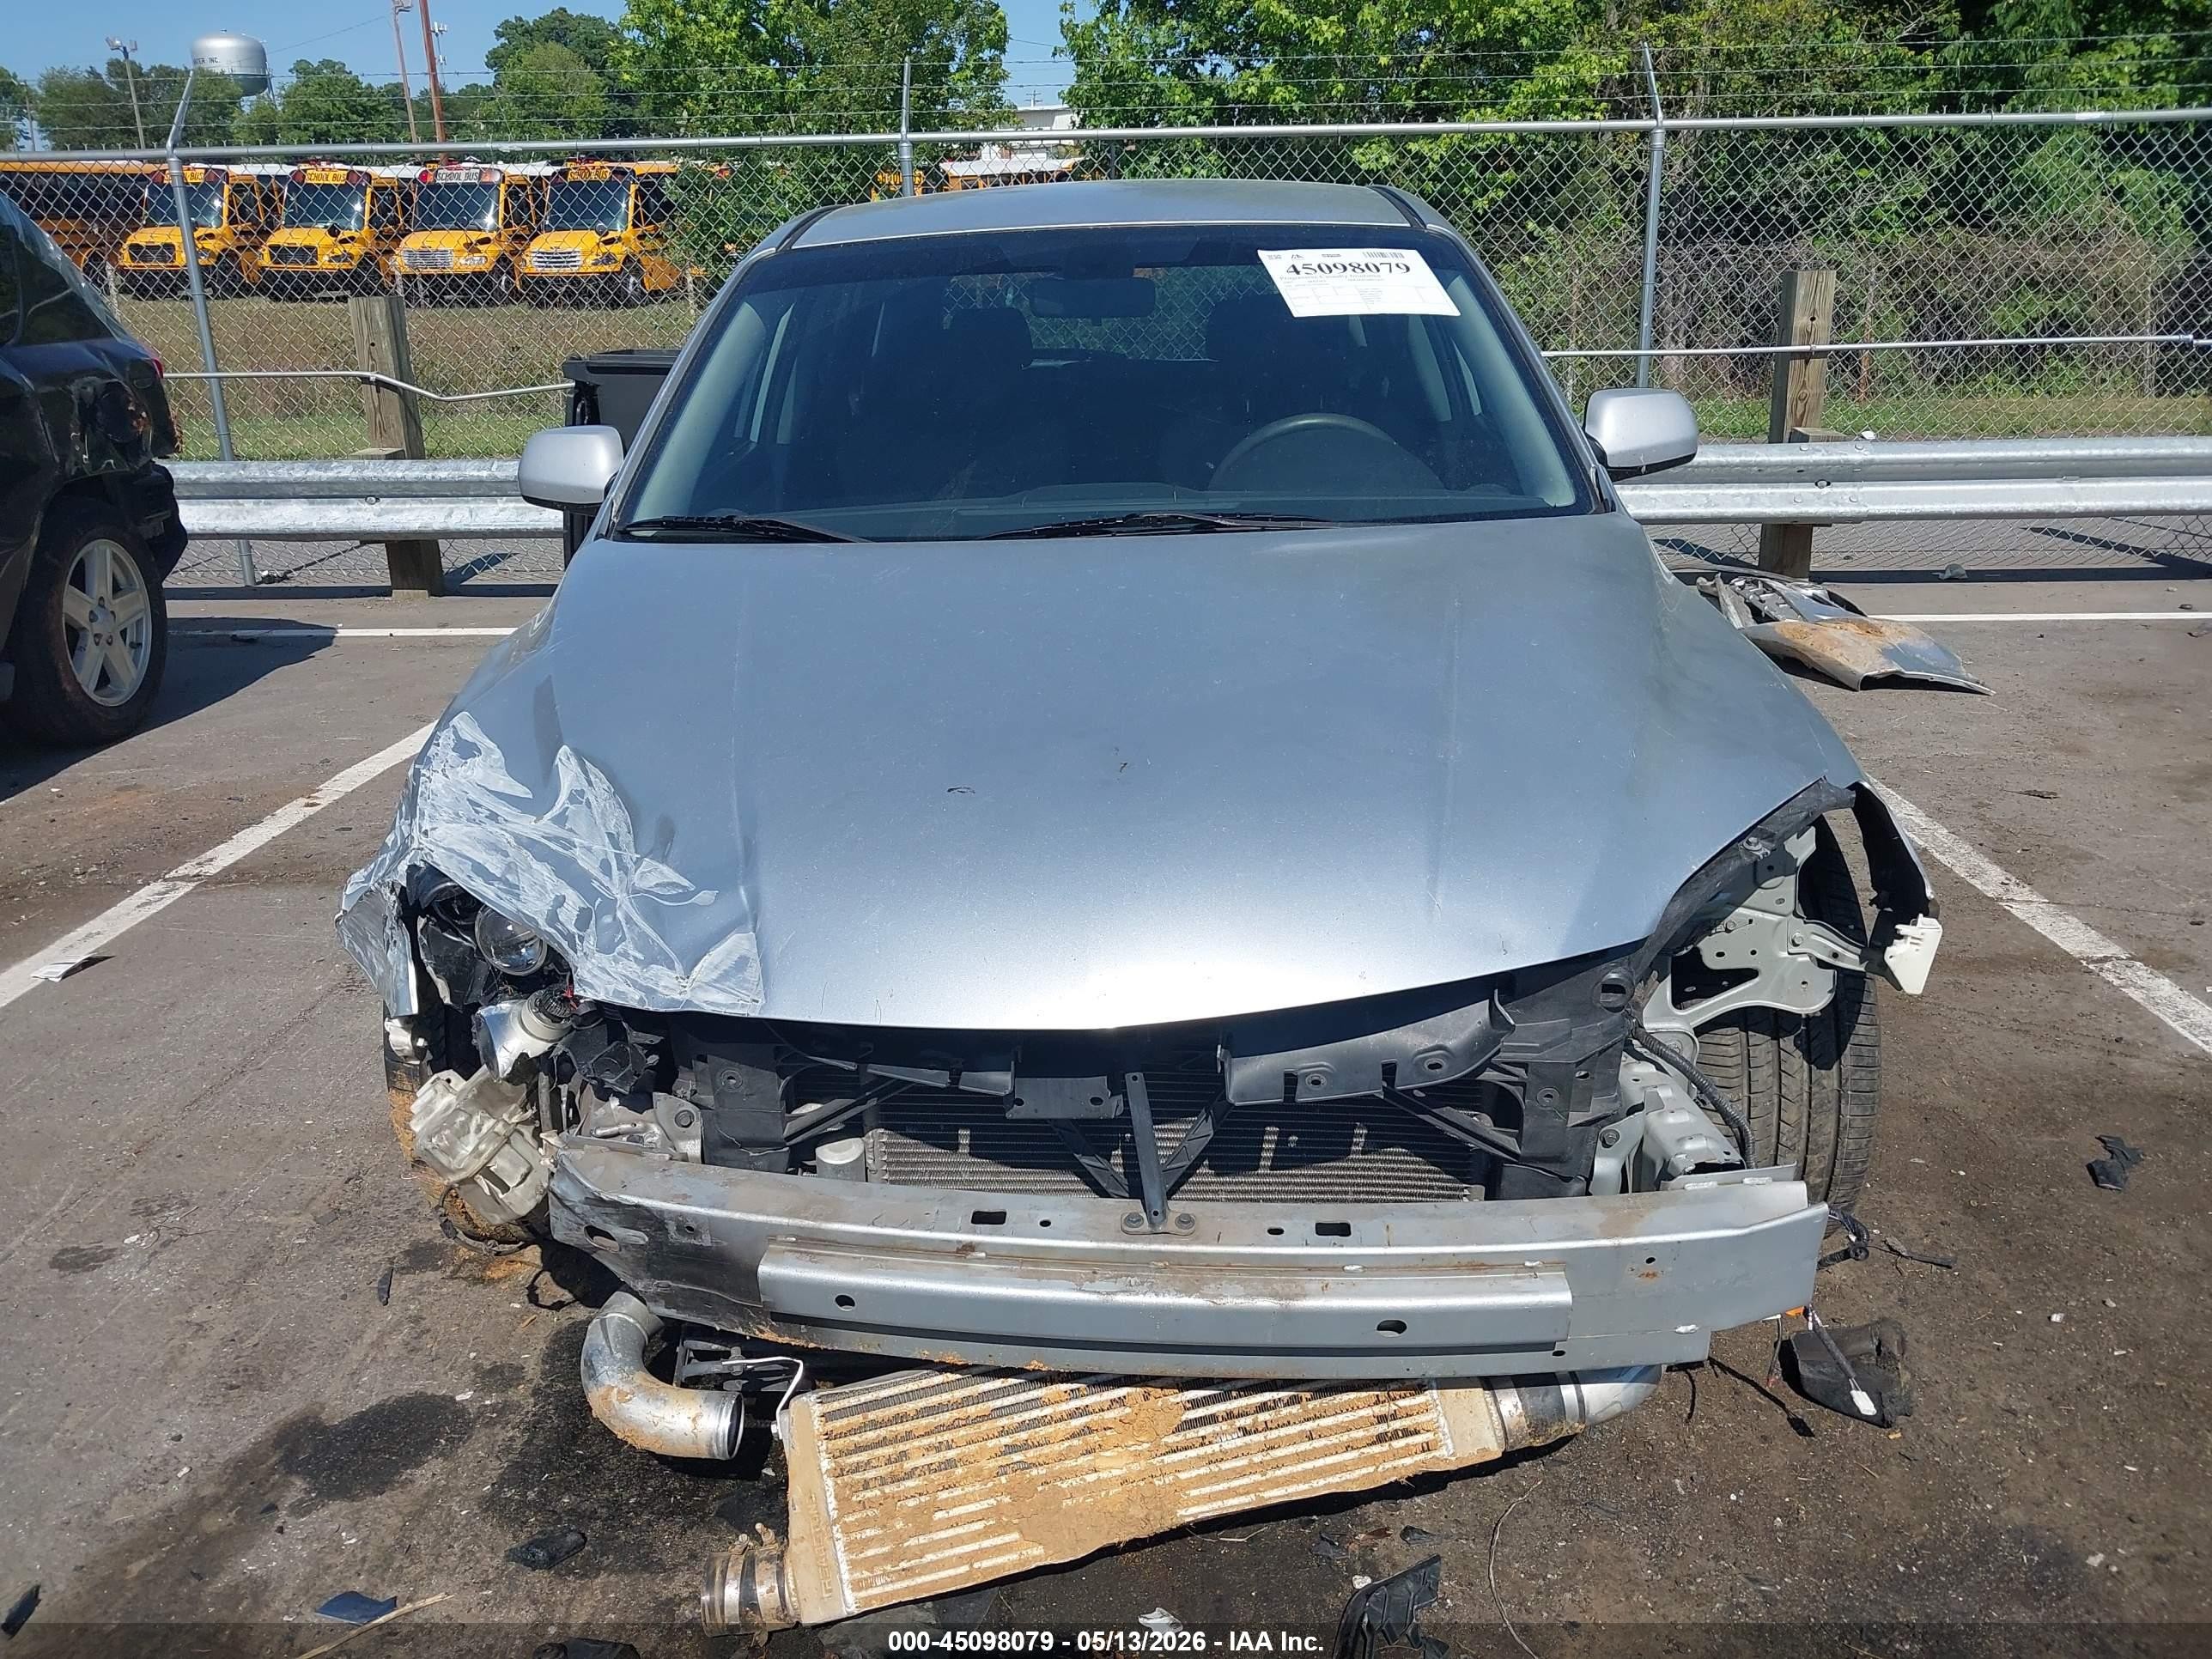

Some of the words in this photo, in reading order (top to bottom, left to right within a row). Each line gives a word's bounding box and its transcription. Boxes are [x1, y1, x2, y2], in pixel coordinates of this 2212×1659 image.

[190, 172, 203, 180] BUS
[331, 173, 346, 181] BUS
[438, 172, 462, 181] SCHOOL
[465, 172, 479, 181] BUS
[1286, 261, 1411, 276] 45098079
